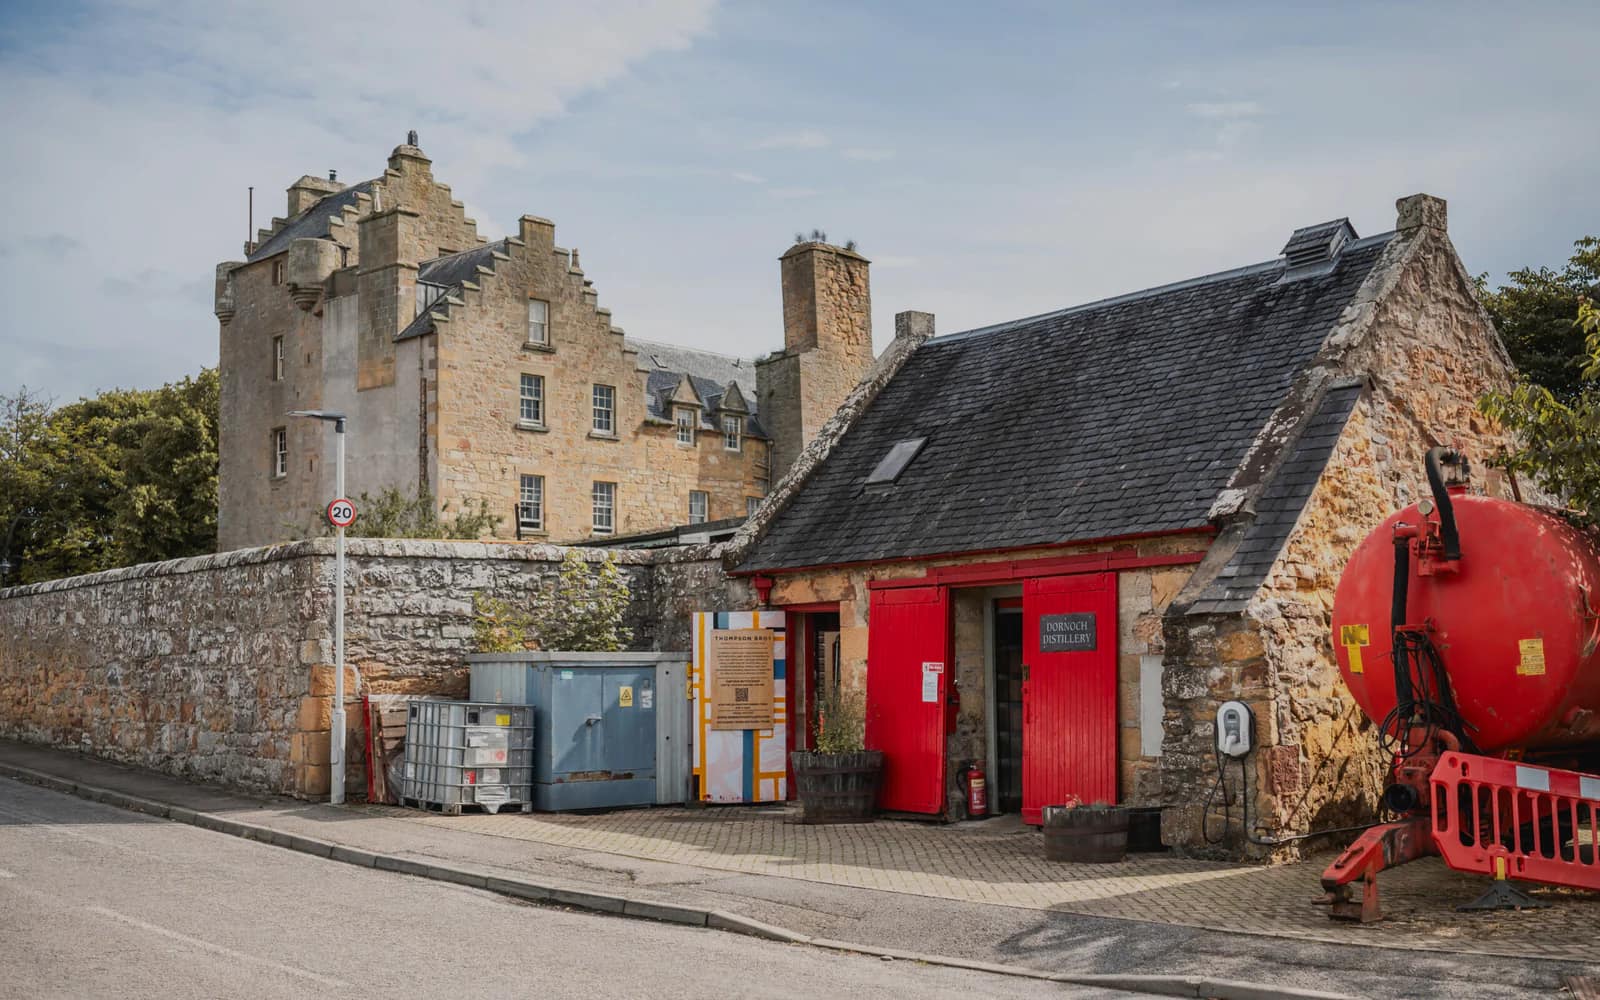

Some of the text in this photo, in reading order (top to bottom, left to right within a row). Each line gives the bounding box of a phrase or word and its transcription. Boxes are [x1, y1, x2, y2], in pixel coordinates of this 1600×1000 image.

[333, 506, 352, 519] 20
[1046, 621, 1088, 632] DORNOCH
[1043, 633, 1091, 645] DISTILLERY
